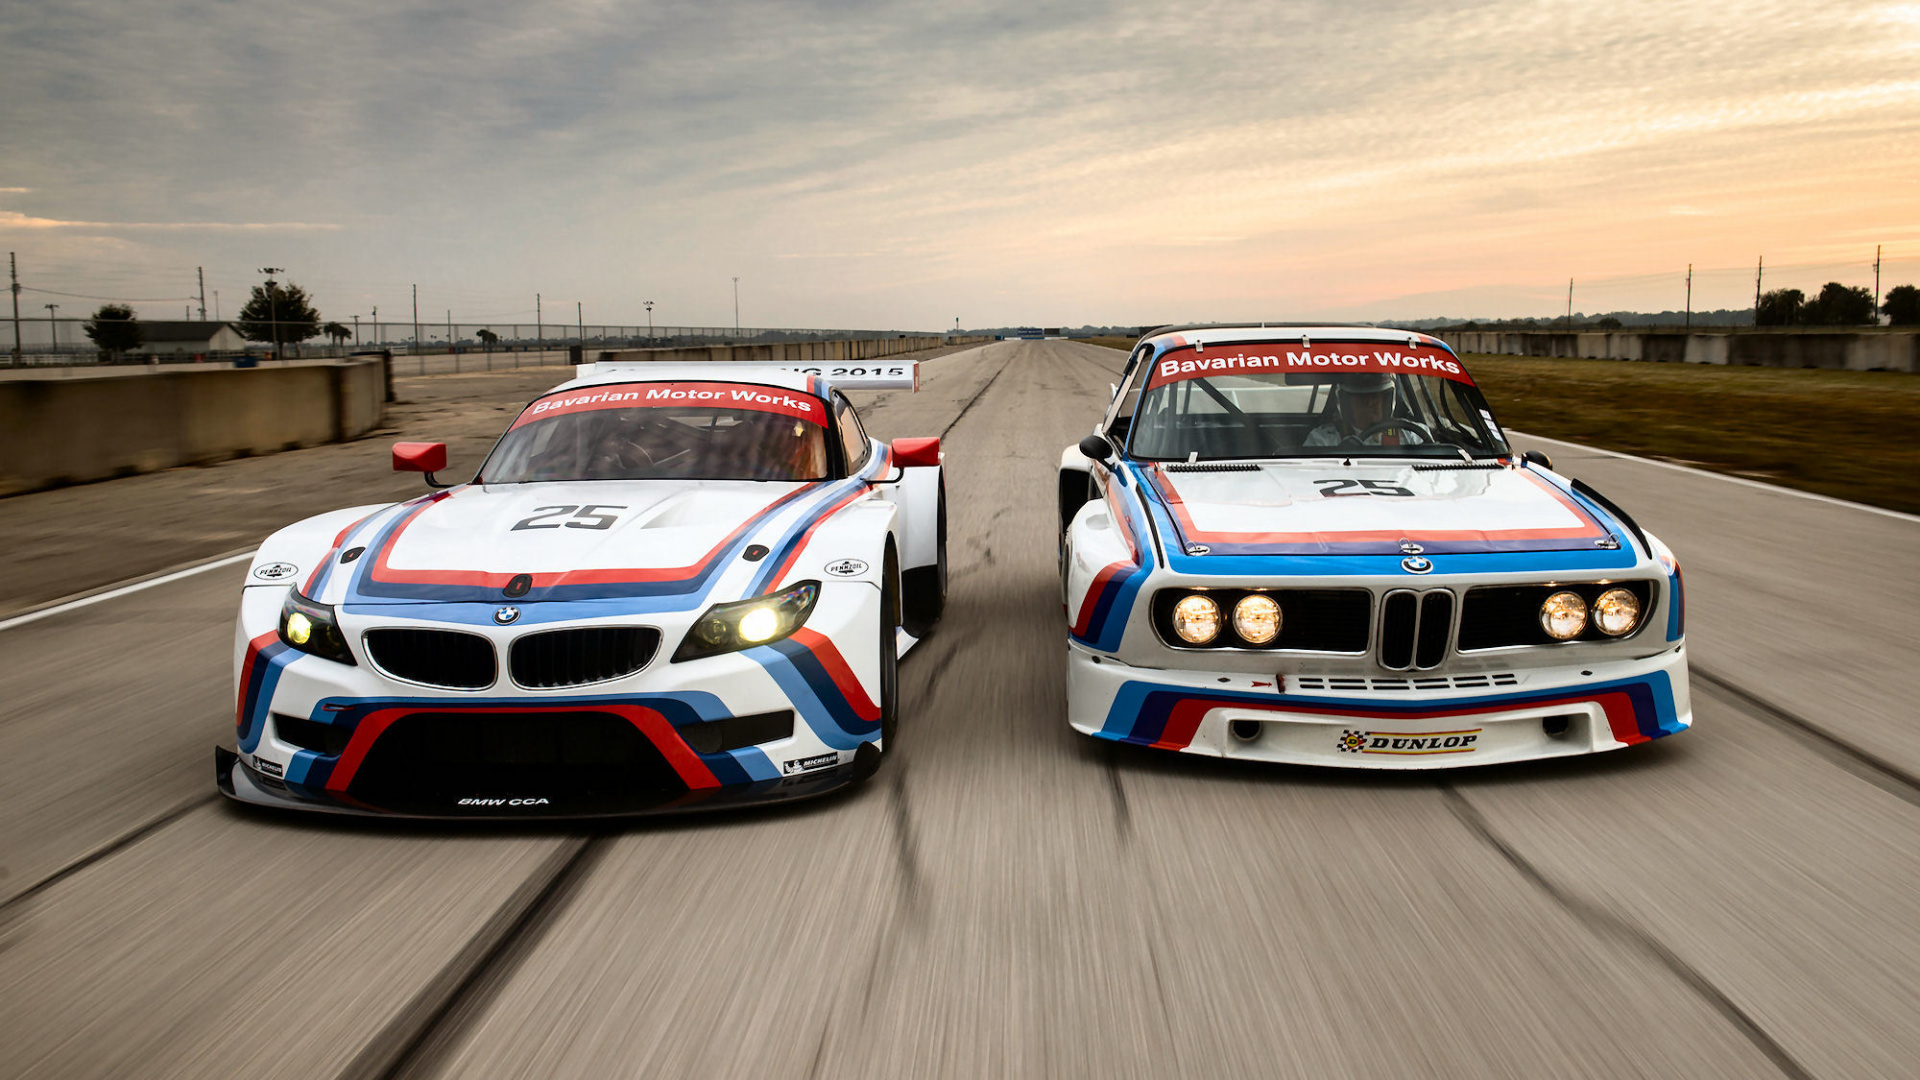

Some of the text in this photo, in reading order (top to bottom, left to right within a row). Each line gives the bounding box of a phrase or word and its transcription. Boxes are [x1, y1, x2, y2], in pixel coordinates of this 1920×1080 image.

[831, 367, 904, 376] 2015
[1160, 351, 1460, 377] Bavarian Motor Works
[532, 389, 811, 415] Bavarian Motor Works
[1313, 479, 1415, 497] 25
[510, 504, 628, 531] 25
[1369, 735, 1477, 750] DUNLOP
[803, 755, 837, 766] MICHELIN
[458, 798, 549, 806] BMW CCA
